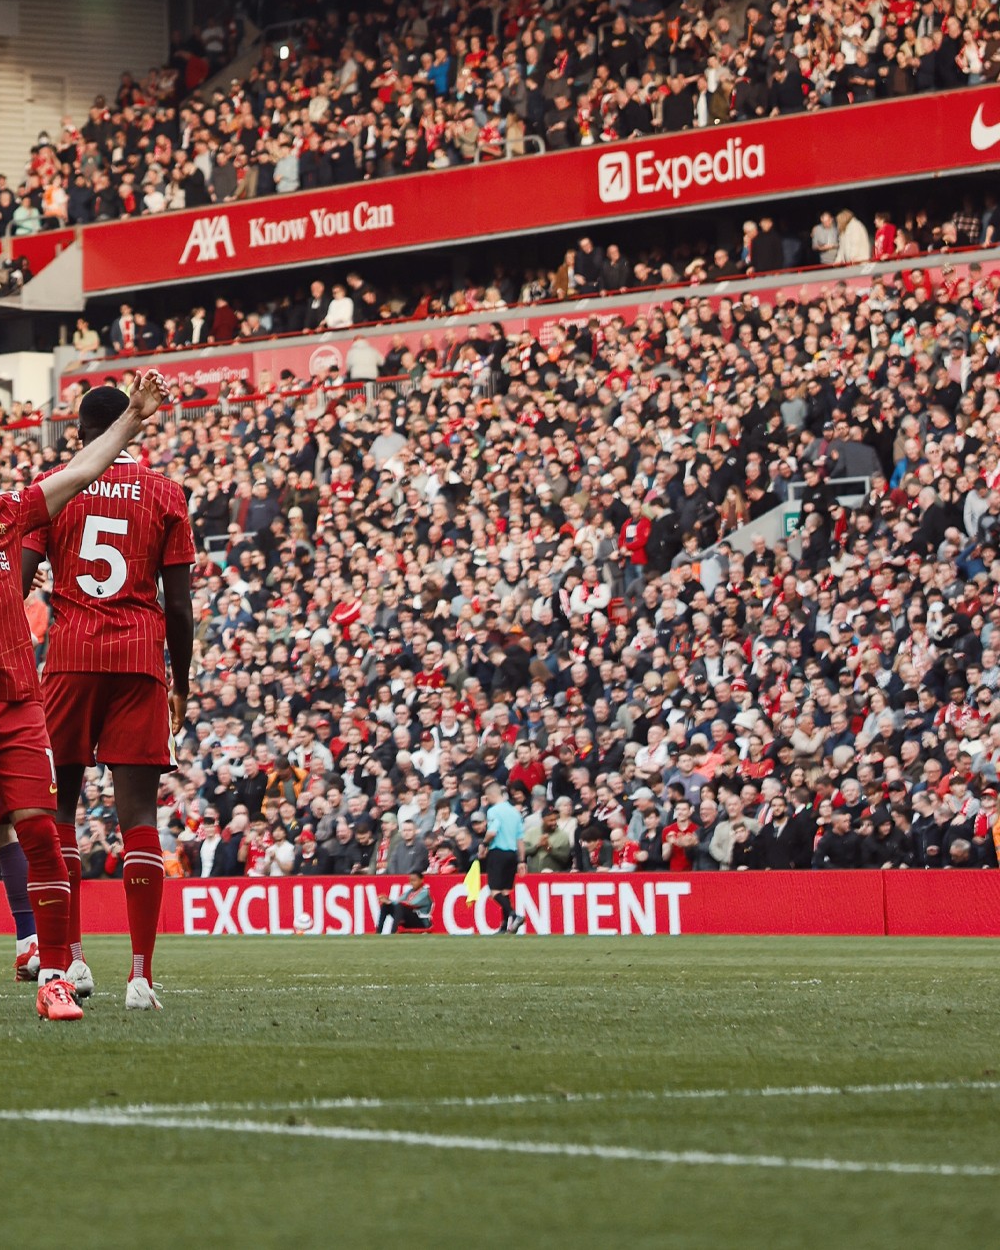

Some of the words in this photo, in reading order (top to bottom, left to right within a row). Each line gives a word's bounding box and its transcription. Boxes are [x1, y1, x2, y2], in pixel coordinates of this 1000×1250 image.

[635, 137, 766, 198] Expedia
[178, 214, 236, 264] AXA
[248, 216, 309, 248] Know
[310, 208, 350, 238] You
[353, 201, 395, 231] Can
[76, 515, 129, 599] 5
[182, 885, 430, 935] EXCLUSIV
[442, 882, 692, 935] CONTENT
